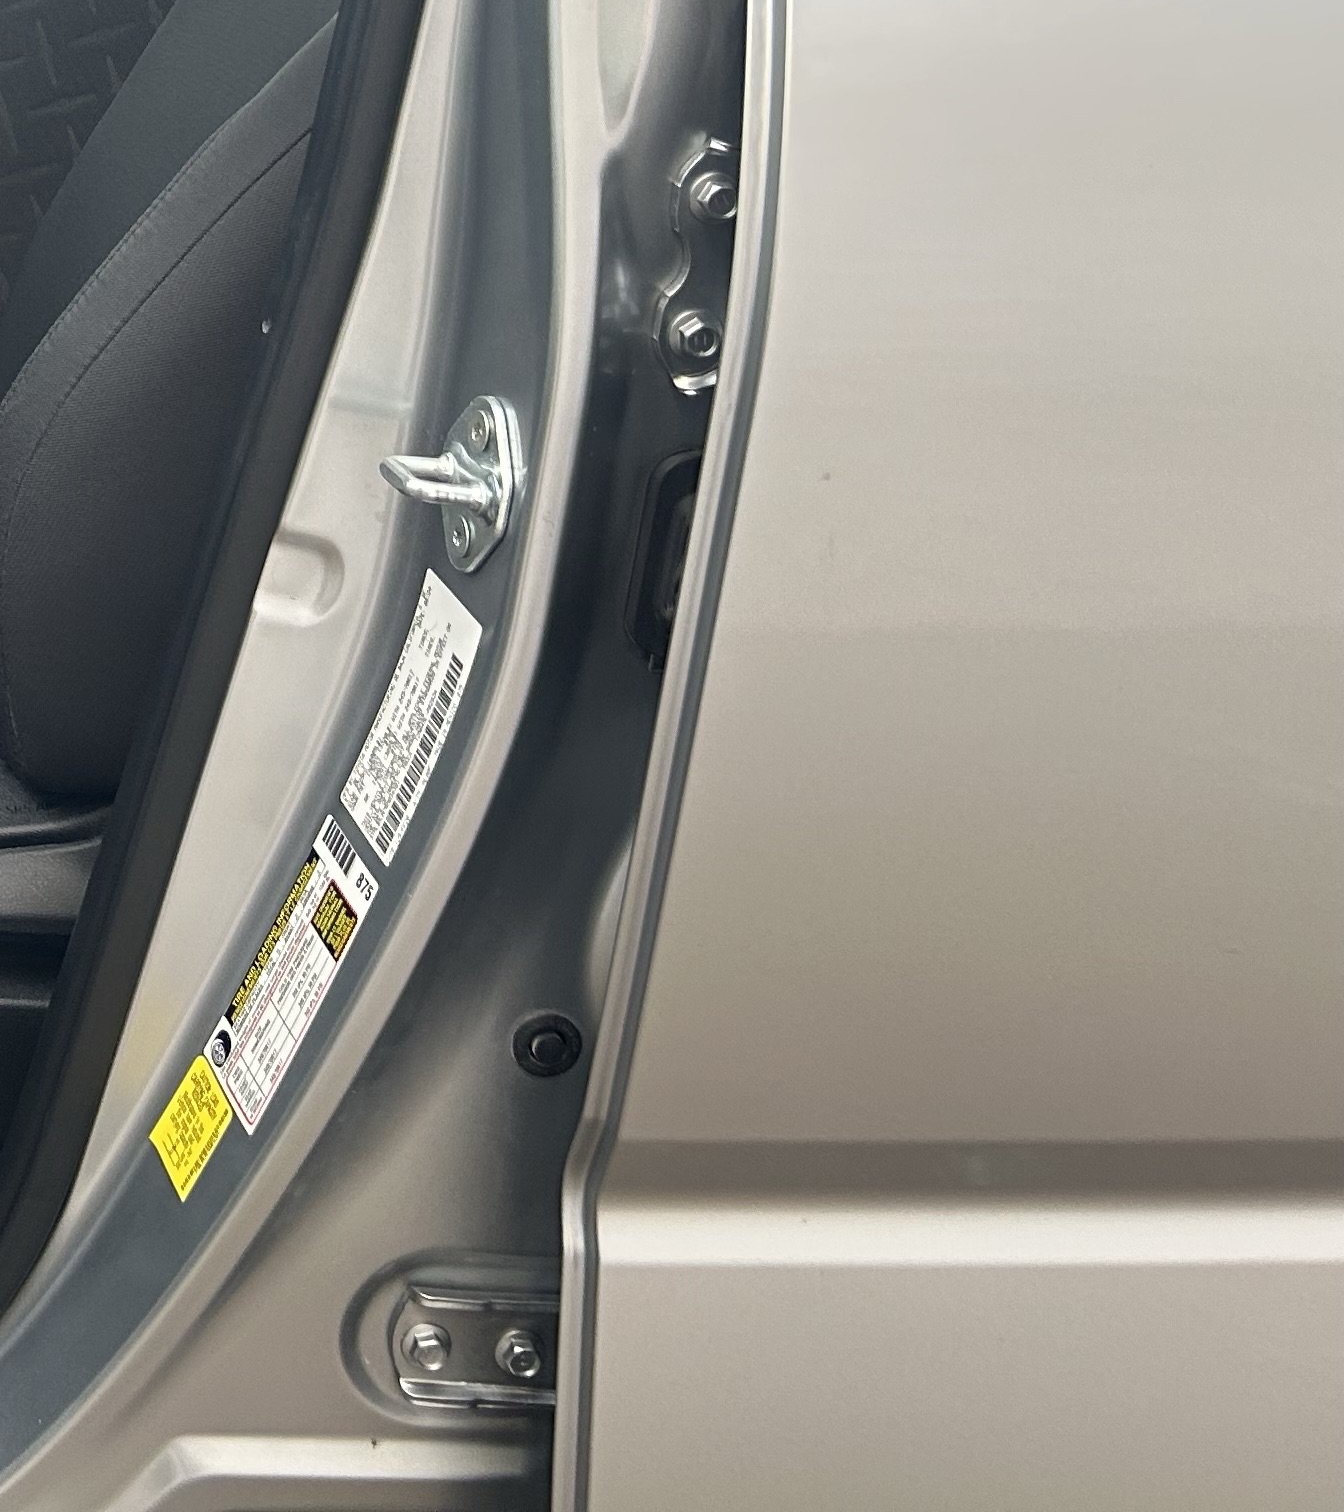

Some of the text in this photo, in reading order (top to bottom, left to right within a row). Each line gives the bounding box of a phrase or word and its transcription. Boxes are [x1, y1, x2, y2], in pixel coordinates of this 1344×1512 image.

[355, 871, 374, 902] 875
[232, 861, 310, 1008] TIRE AND LOADING INFORMATION
